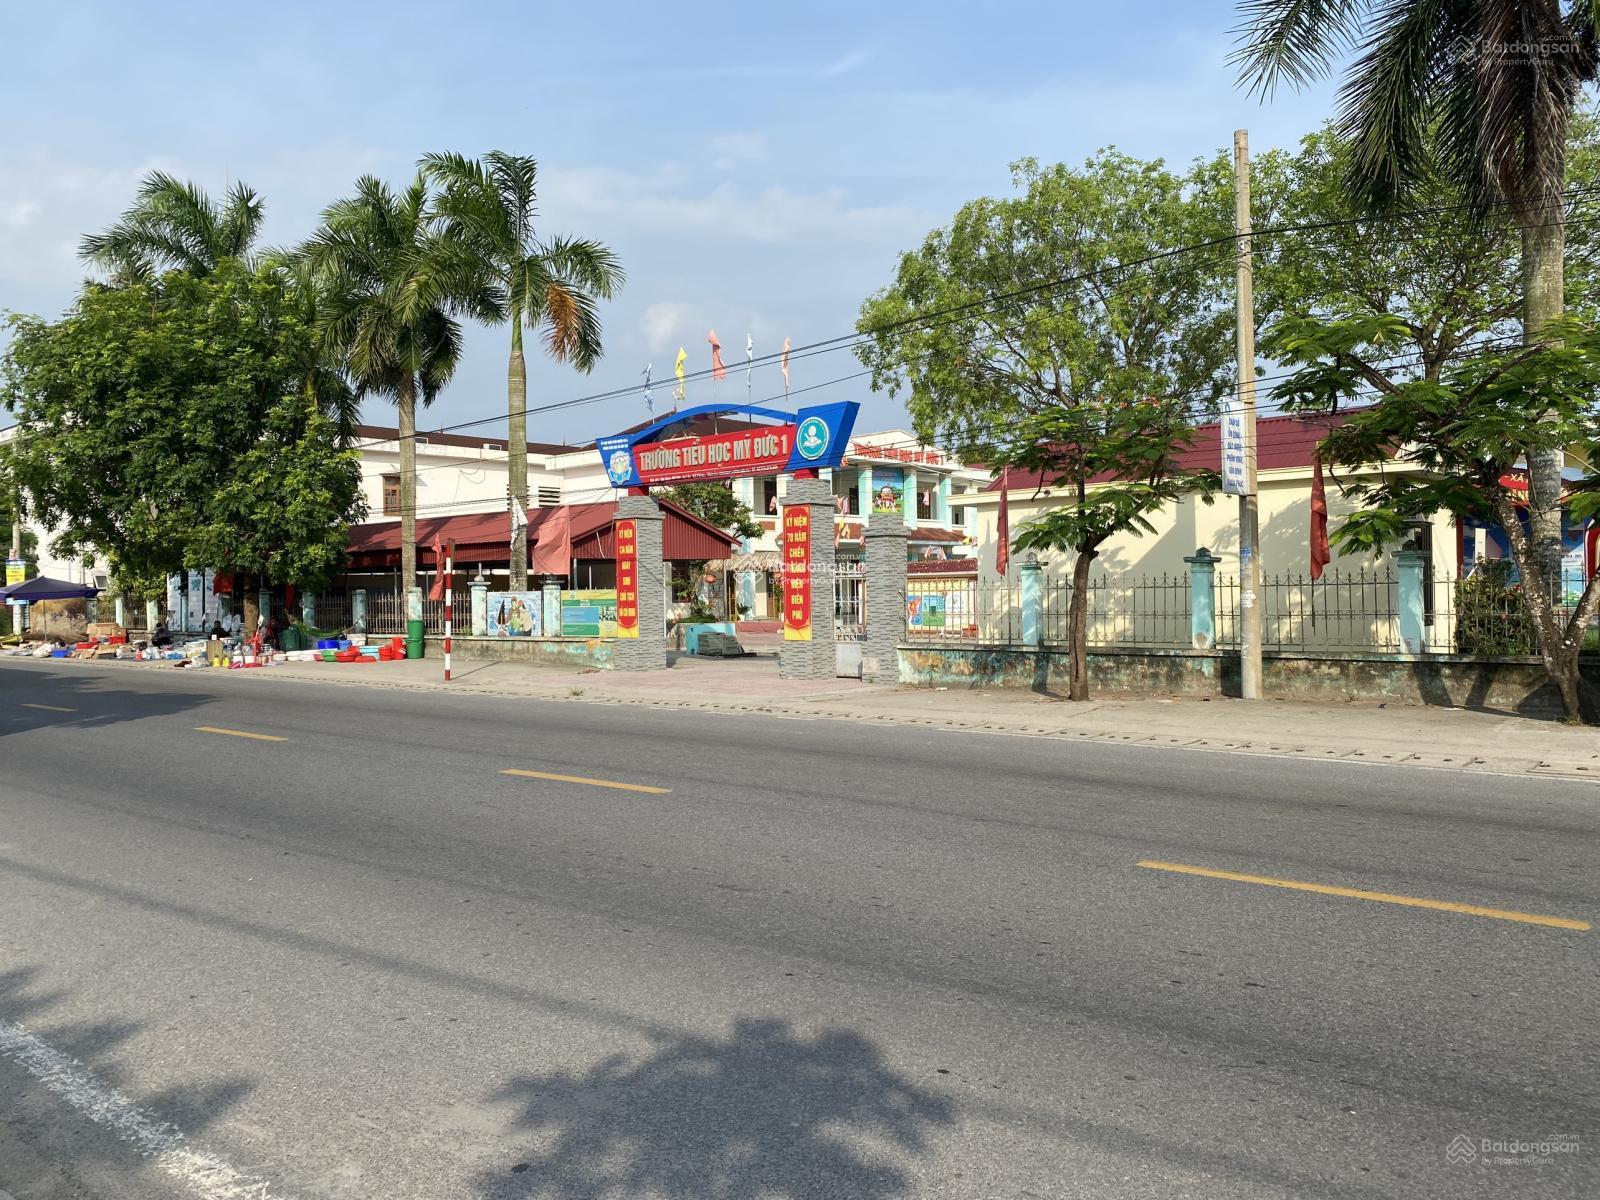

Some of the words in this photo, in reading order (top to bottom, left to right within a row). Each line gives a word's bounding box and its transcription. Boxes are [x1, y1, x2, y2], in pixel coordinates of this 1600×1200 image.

[639, 445, 681, 471] TRƯỜNG
[682, 438, 705, 466] TIỂU
[708, 441, 731, 467] HỌC
[733, 433, 751, 461] MỸ
[754, 429, 779, 458] ĐỨC
[780, 434, 788, 455] 1
[787, 532, 794, 543] 70
[794, 531, 807, 542] NĂM
[790, 545, 805, 558] CHIẾN
[791, 607, 803, 620] PHỦ
